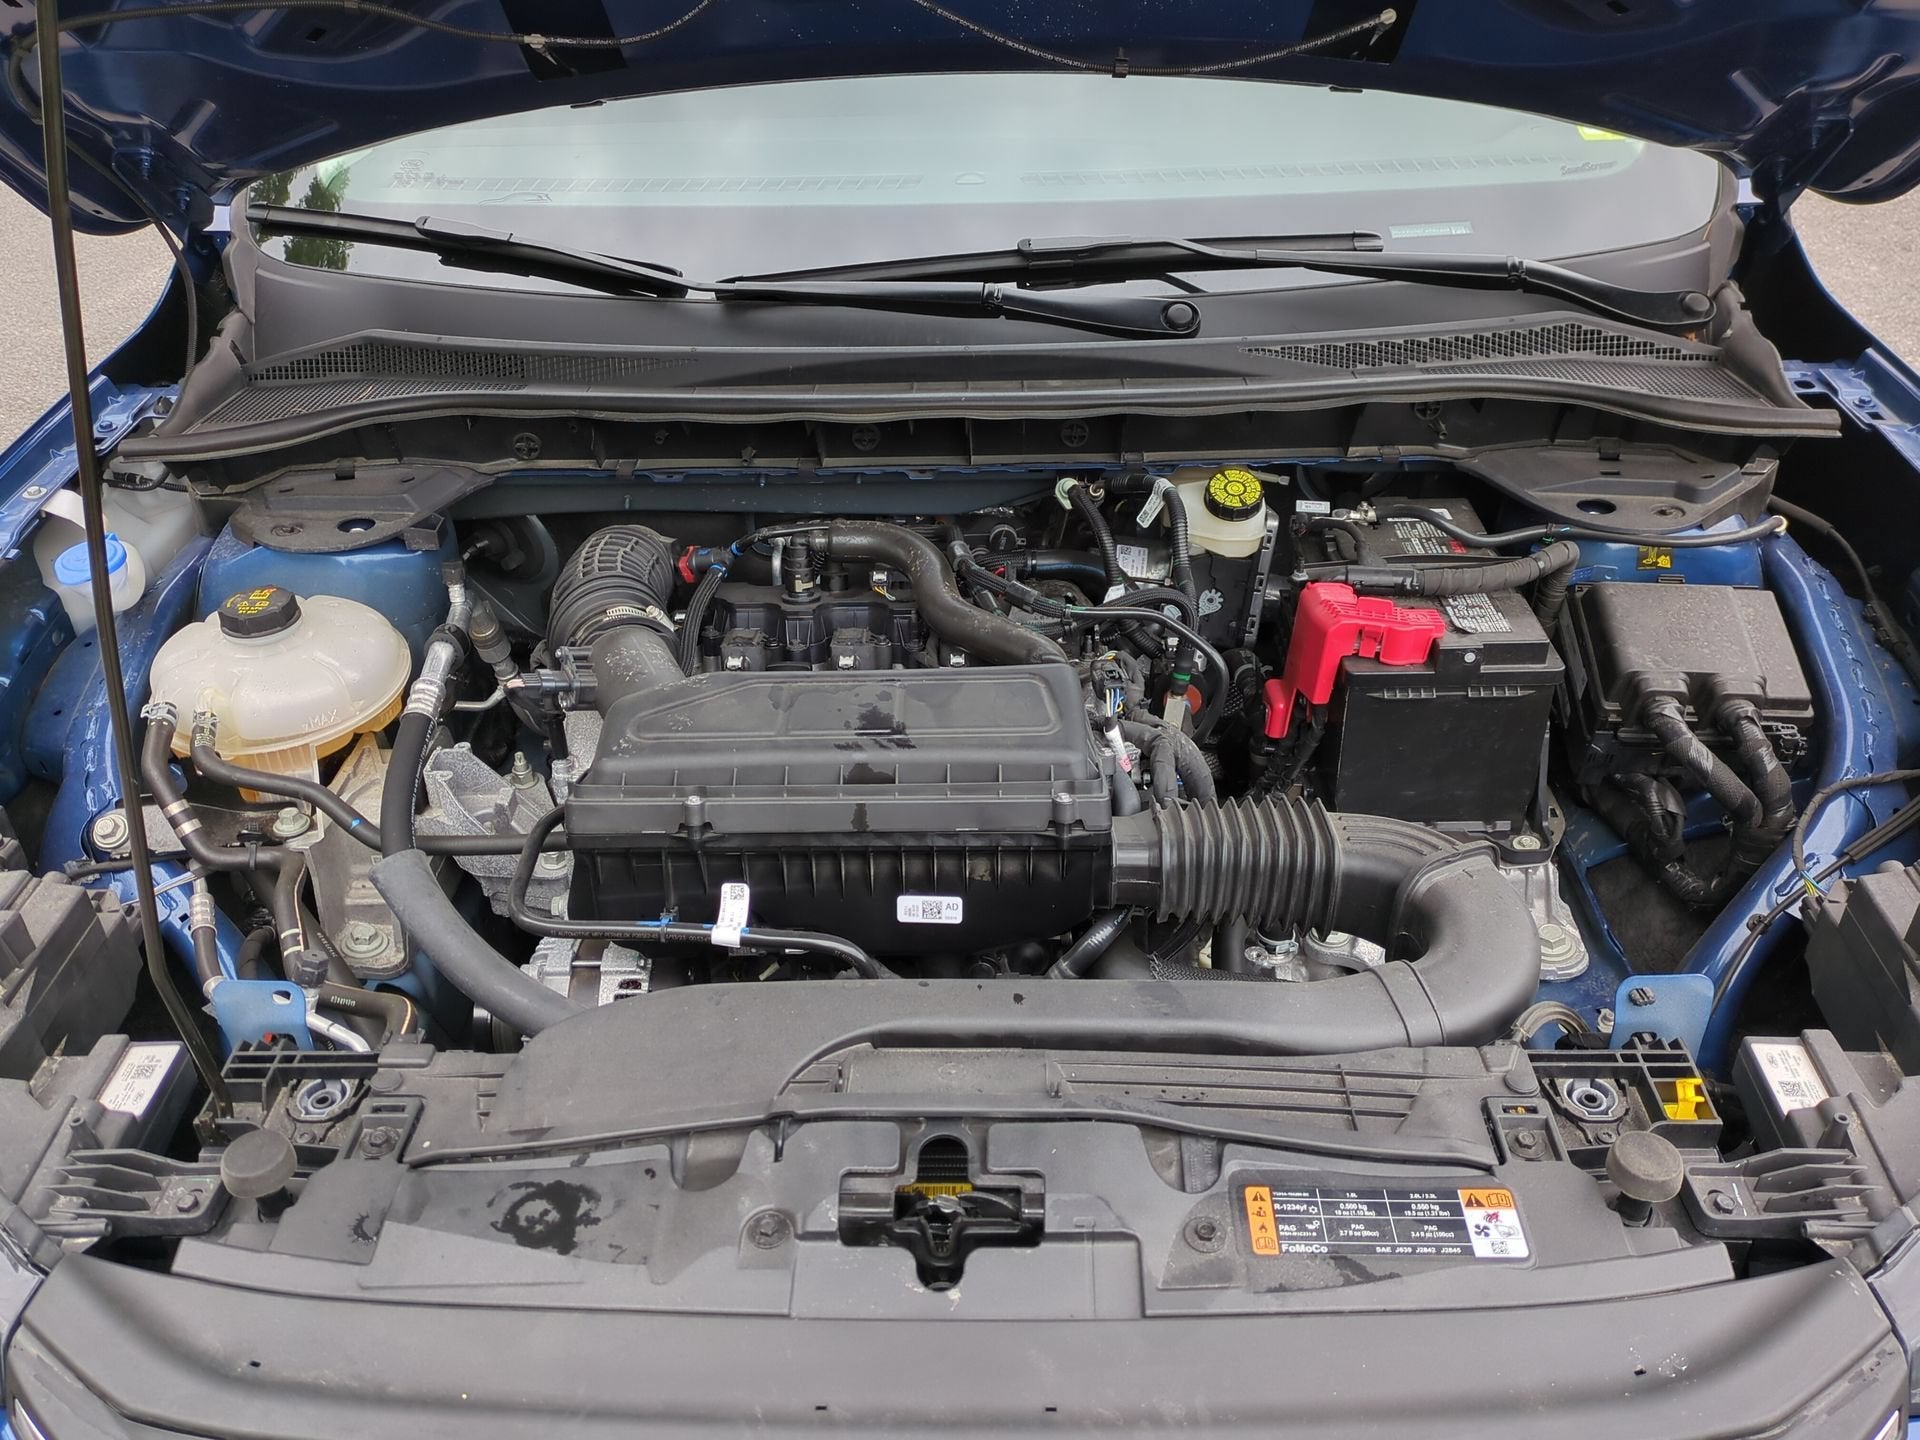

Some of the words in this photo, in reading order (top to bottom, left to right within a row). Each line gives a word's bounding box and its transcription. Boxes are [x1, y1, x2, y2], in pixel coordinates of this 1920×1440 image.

[945, 903, 959, 911] AD
[1274, 1203, 1307, 1212] R-1234yf
[1358, 1203, 1368, 1211] kg
[1430, 1203, 1440, 1212] kg
[1281, 1244, 1328, 1253] FoMoCo
